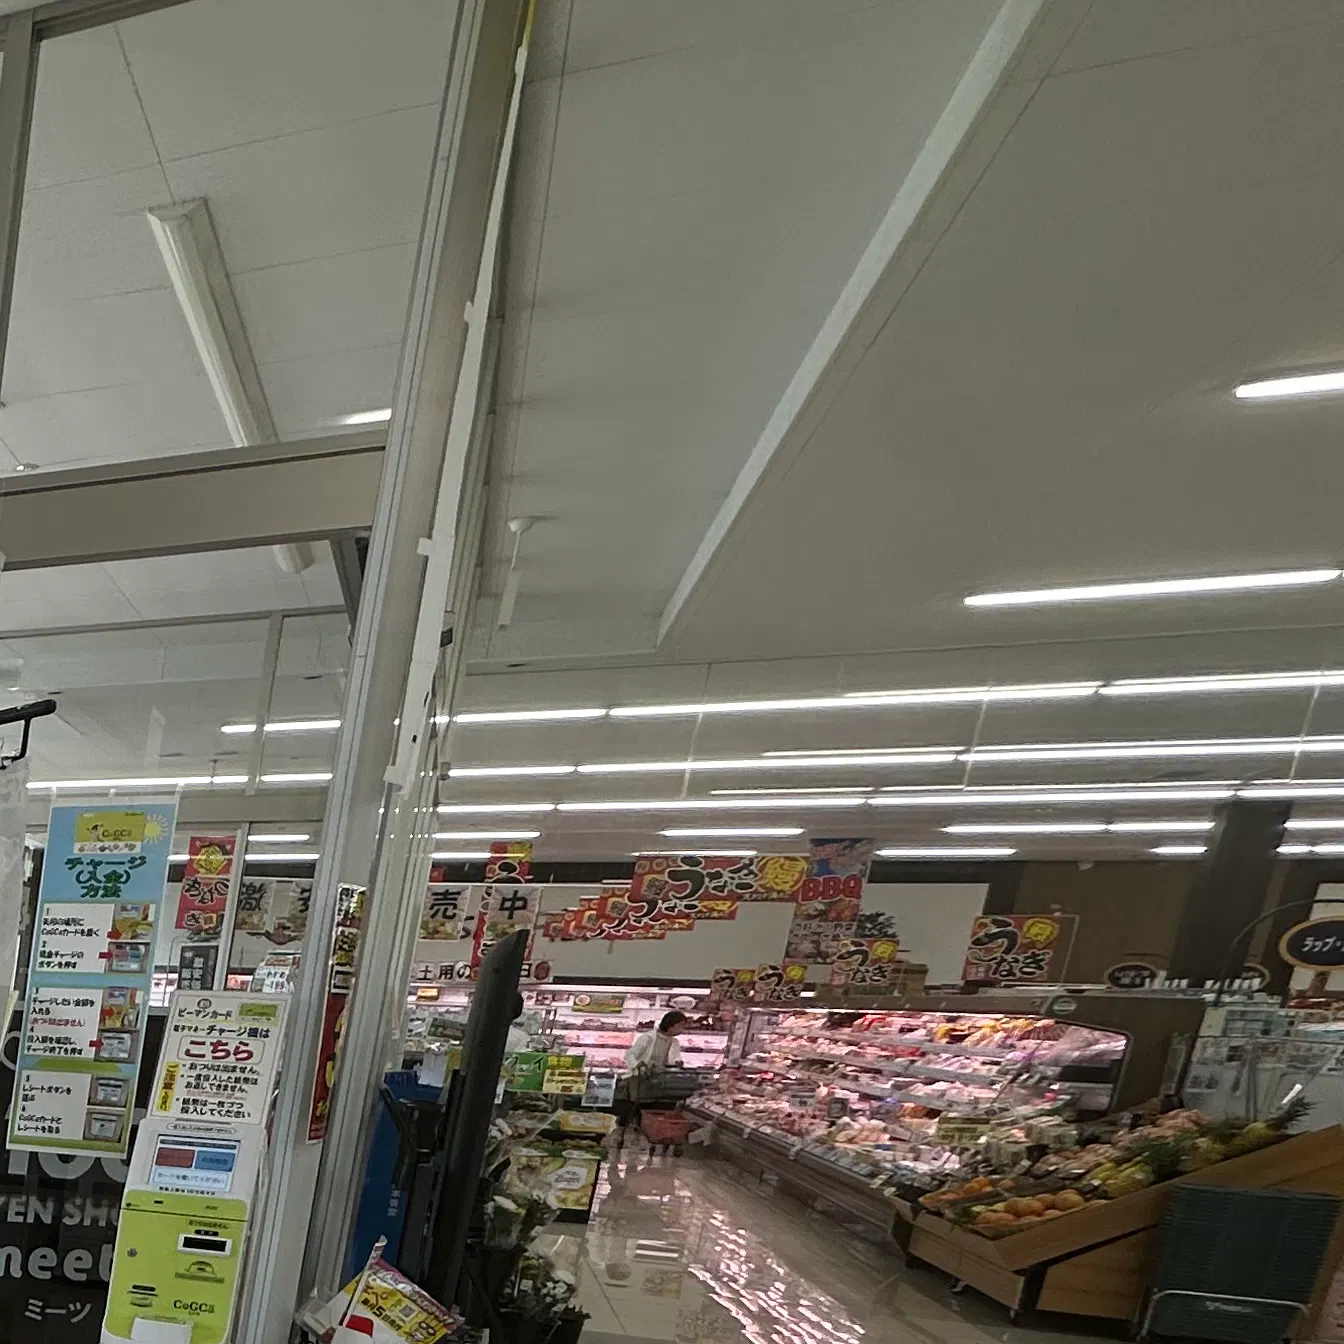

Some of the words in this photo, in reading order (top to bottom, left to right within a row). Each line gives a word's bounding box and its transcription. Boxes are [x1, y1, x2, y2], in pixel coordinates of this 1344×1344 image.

[64, 855, 148, 871] チャージ
[75, 868, 132, 885] (入金)
[802, 874, 863, 902] BBQ
[80, 883, 123, 898] 方法
[429, 888, 461, 920] 売
[498, 889, 528, 921] 中
[1301, 936, 1344, 953] ラップ・
[178, 1007, 233, 1021] ピーマンカード
[184, 1039, 254, 1062] こちら
[62, 1196, 118, 1227] SH
[24, 1298, 92, 1324] ミーツ
